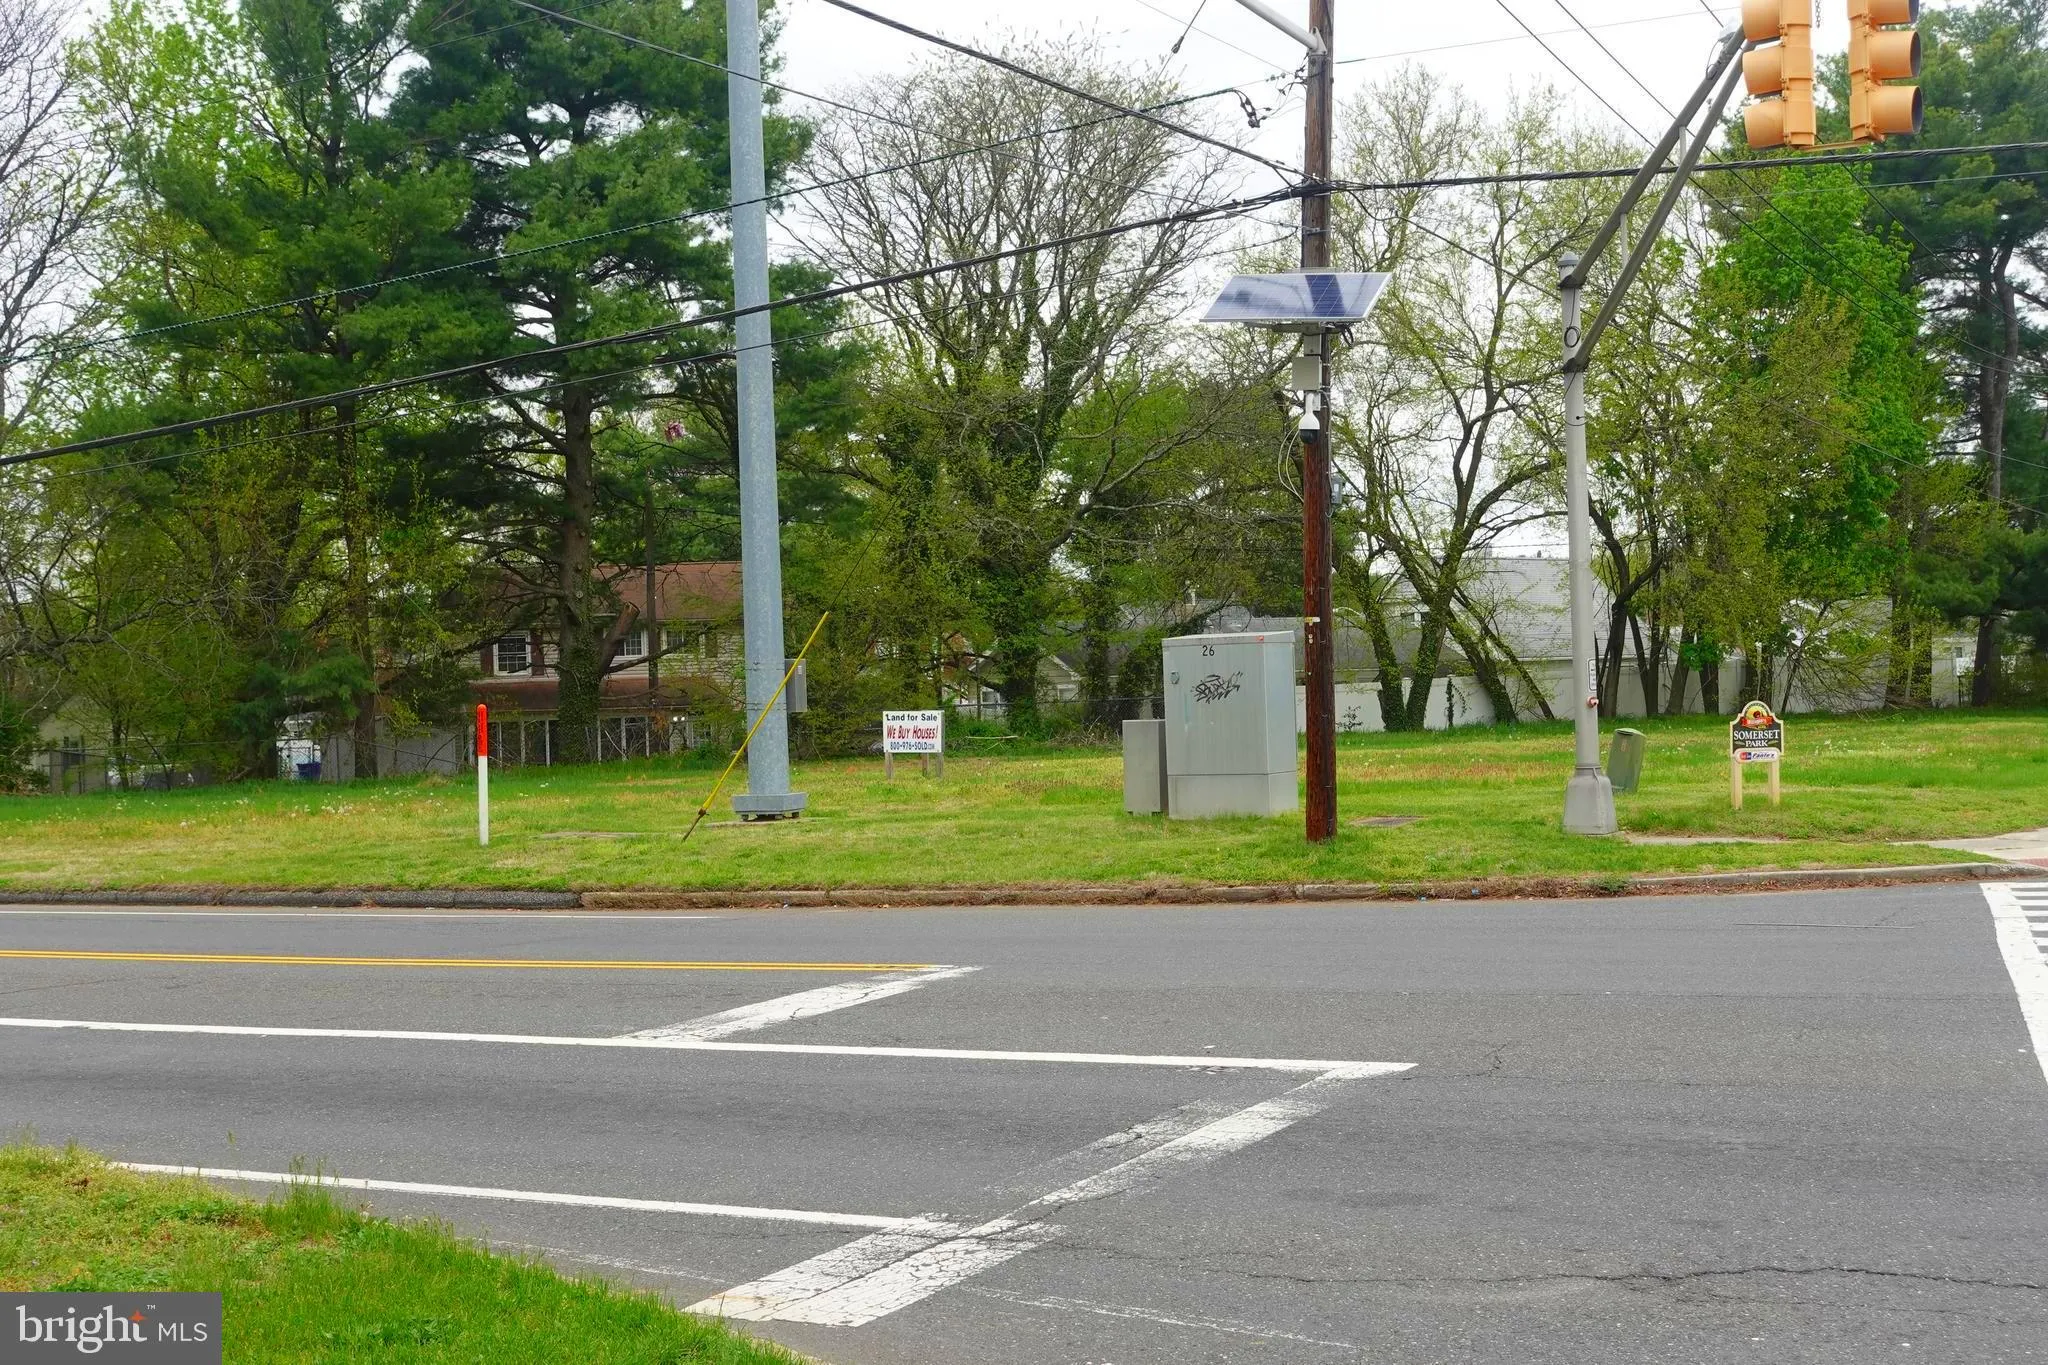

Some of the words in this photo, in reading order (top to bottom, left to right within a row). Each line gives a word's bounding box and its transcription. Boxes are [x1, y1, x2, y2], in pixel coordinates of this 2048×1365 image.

[1202, 645, 1215, 656] 26
[886, 713, 905, 721] Land
[907, 713, 918, 721] for
[921, 713, 937, 721] Sale
[898, 725, 911, 739] BUY
[912, 724, 939, 739] HOUSES!
[1733, 730, 1780, 740] SOMERSET
